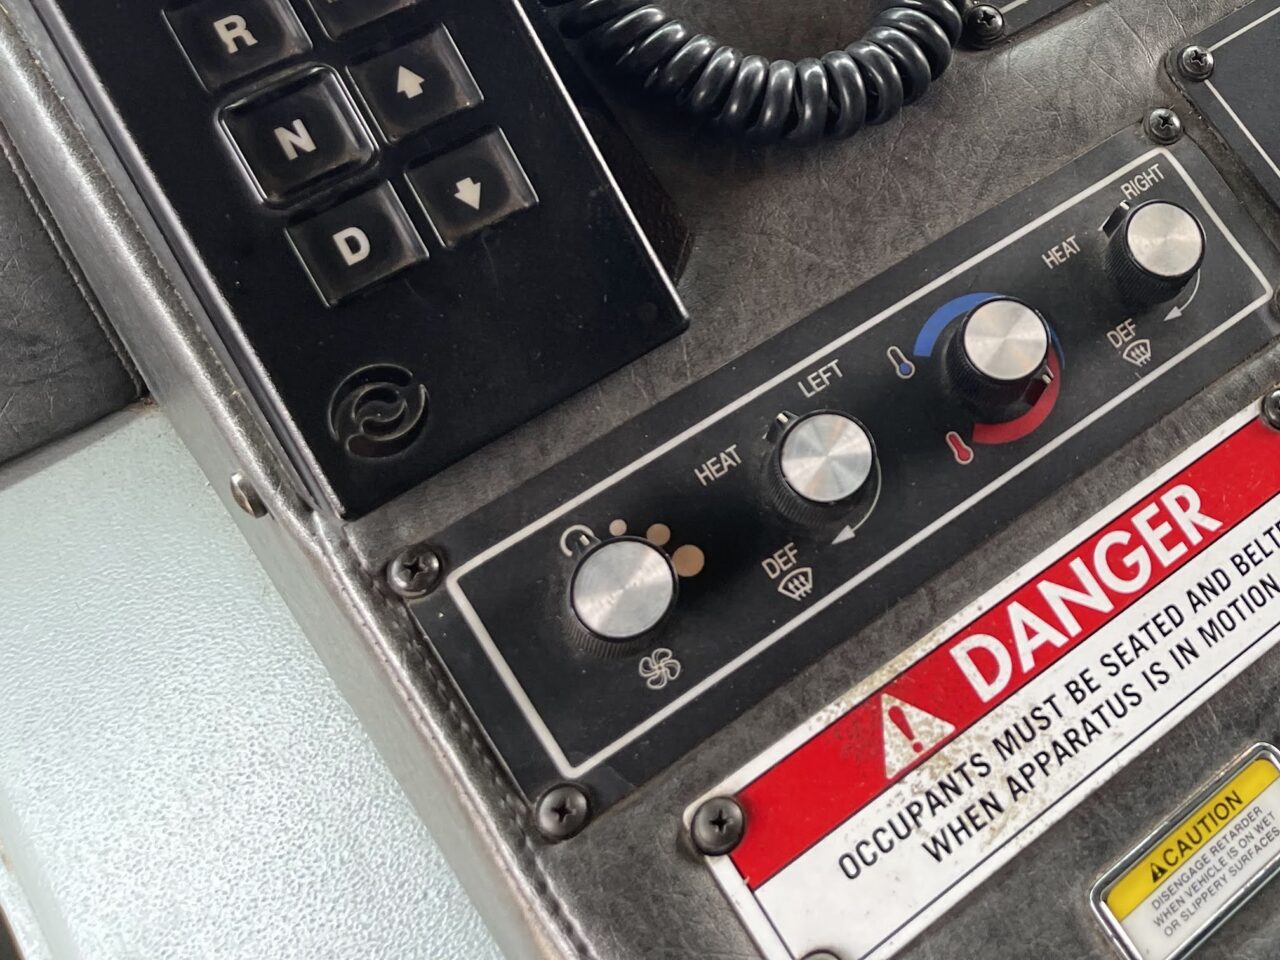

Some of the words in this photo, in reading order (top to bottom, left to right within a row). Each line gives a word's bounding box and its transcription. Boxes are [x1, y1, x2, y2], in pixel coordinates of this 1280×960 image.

[213, 14, 258, 54] R
[274, 118, 317, 161] N
[1120, 163, 1165, 201] RIGHT
[332, 226, 371, 266] D
[1041, 235, 1081, 269] HEAT
[1106, 319, 1138, 349] DEF
[798, 359, 845, 398] LEFT
[694, 444, 743, 486] HEAT
[762, 543, 799, 580] DEF
[950, 484, 1223, 704] DANGER
[838, 752, 991, 880] OCCUPANTS
[992, 694, 1064, 762] MUST
[1064, 668, 1101, 705] BE
[1100, 604, 1184, 677] SEATED
[1186, 568, 1232, 613] AND
[922, 791, 1005, 863] WHEN
[1006, 683, 1143, 802] APPARATUS
[1142, 661, 1170, 692] IS
[1169, 637, 1200, 670] IN
[1163, 790, 1244, 867] CAUTION
[1152, 852, 1211, 910] DISENGAGE
[1210, 806, 1263, 855] RETARDER
[1153, 897, 1187, 928] WHEN
[1185, 858, 1229, 897] VEHICLE
[1228, 847, 1239, 860] IS
[1240, 833, 1255, 850] ON
[1255, 811, 1277, 835] WET
[1164, 919, 1181, 937] OR
[1180, 873, 1229, 921] SLIPPERY
[1228, 826, 1280, 877] SURFACES.
